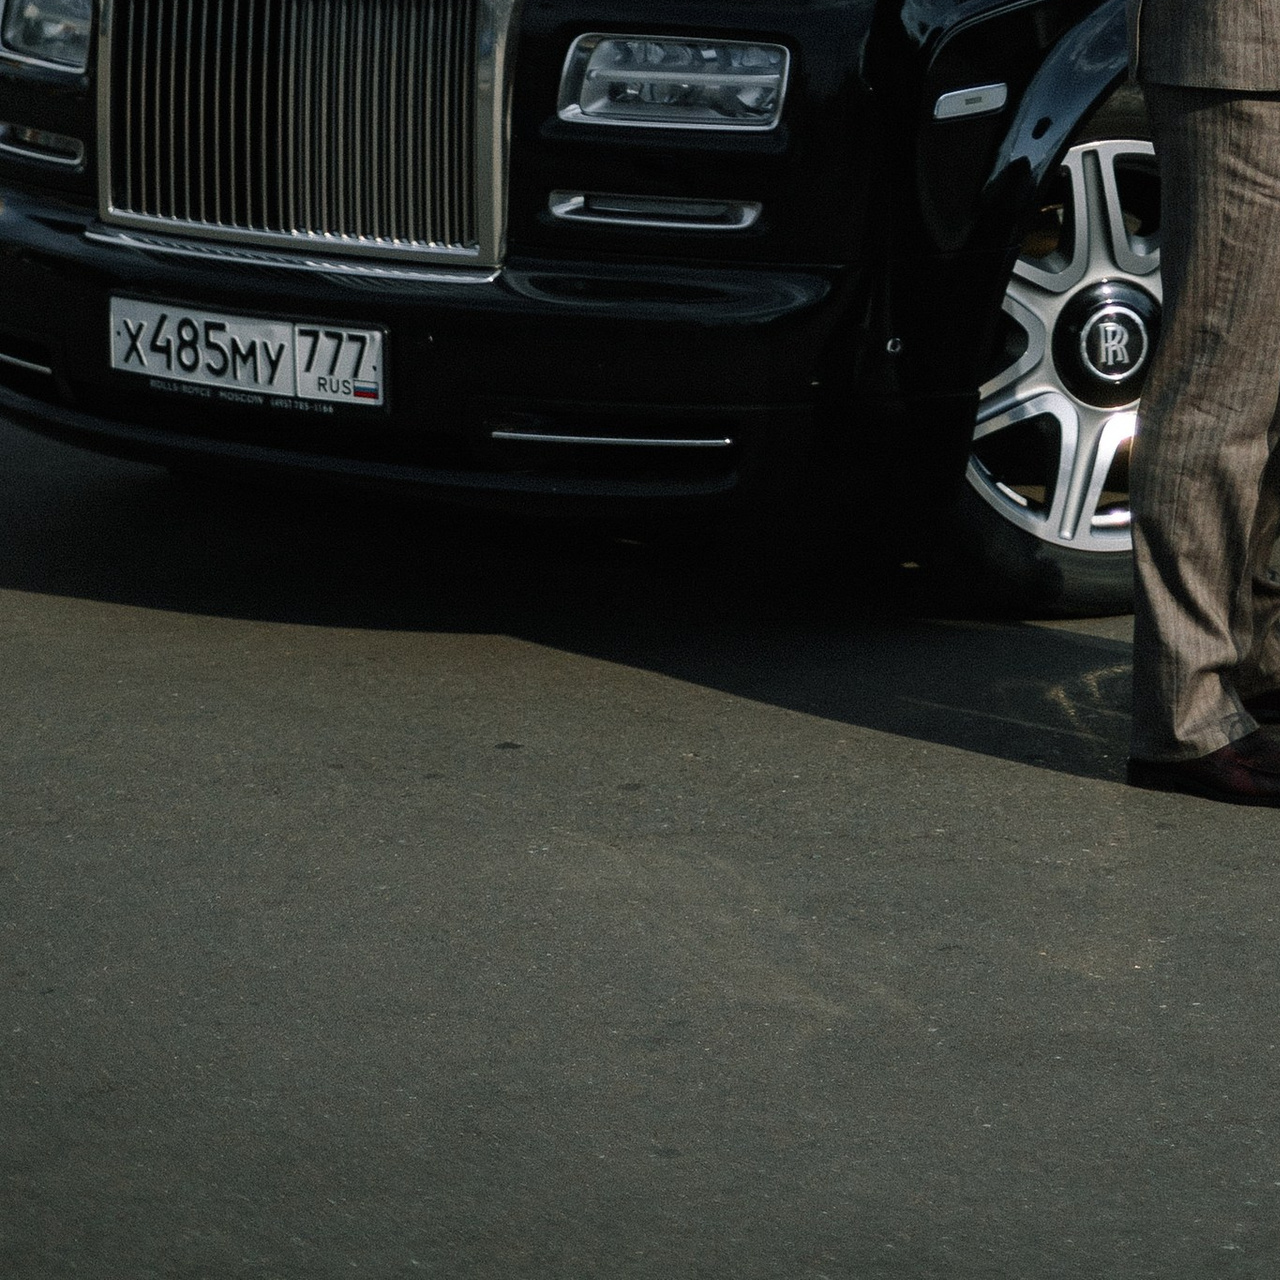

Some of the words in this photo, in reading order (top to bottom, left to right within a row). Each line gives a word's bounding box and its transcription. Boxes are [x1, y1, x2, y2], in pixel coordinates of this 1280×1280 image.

[297, 328, 369, 378] 777
[317, 376, 352, 395] RUS
[219, 390, 264, 404] MOSCOW
